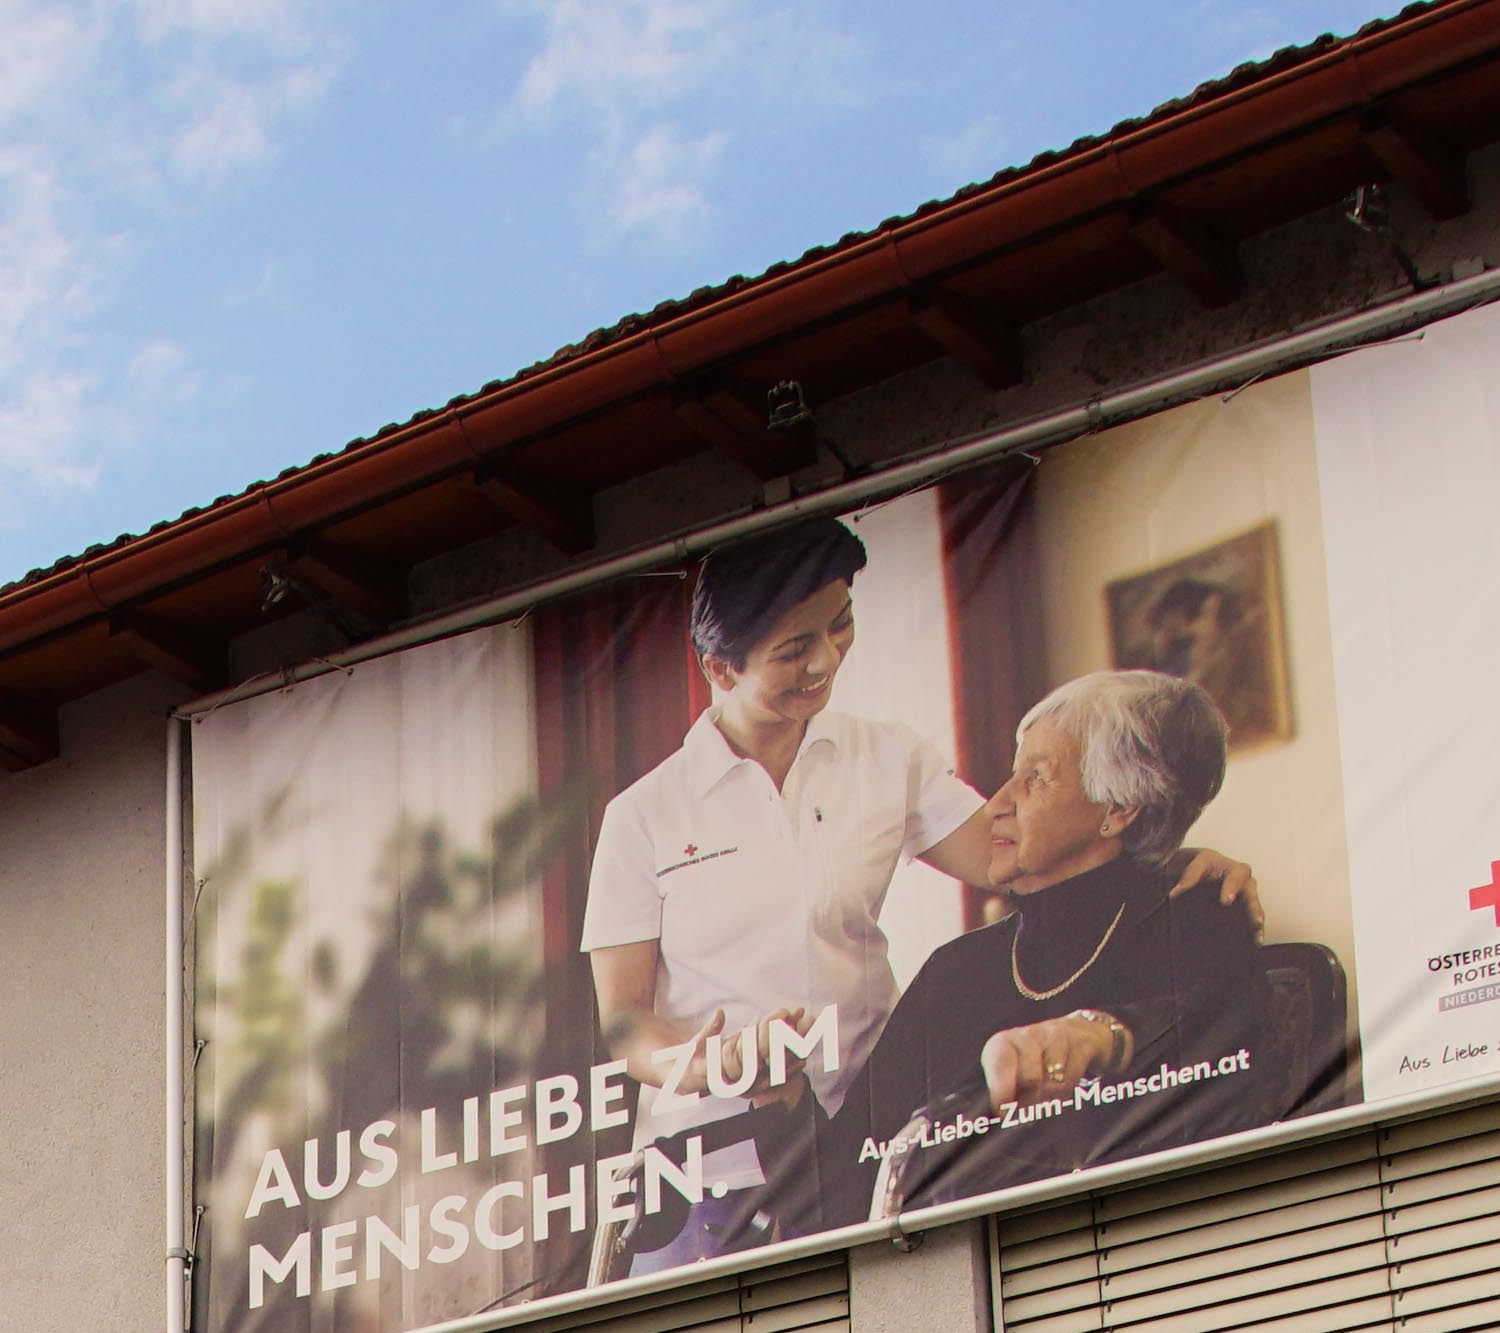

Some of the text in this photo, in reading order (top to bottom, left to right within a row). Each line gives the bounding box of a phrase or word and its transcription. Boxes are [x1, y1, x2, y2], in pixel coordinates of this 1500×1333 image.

[244, 1002, 840, 1219] AUS LIEBE ZUM
[857, 1047, 1251, 1164] Aus-Liebe-Zum-Menschen.at
[1398, 1055, 1432, 1075] Aus
[1442, 1043, 1489, 1065] Liebe
[248, 1134, 729, 1310] MENSCHEN.
